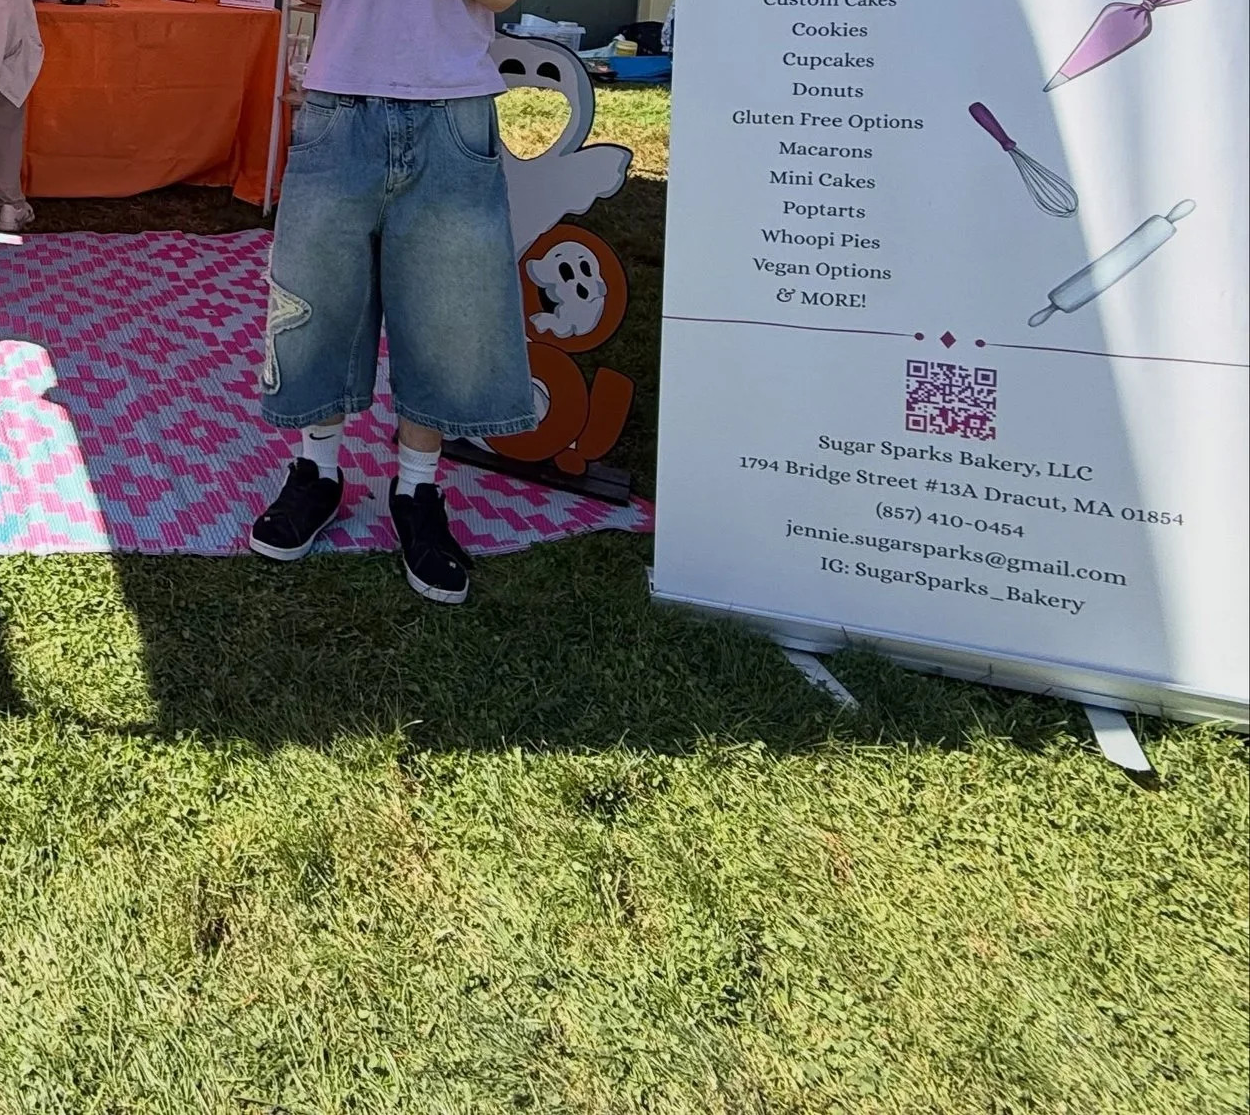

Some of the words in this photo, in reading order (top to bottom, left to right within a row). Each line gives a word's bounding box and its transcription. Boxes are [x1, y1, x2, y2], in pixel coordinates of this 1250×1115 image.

[792, 22, 868, 38] Cookies
[782, 52, 875, 70] Cupcakes
[792, 83, 864, 99] Donuts
[732, 111, 794, 126] Gluten
[800, 113, 842, 128] Free
[848, 114, 924, 132] Options
[778, 142, 873, 159] Macarons
[769, 170, 813, 187] Mini
[818, 173, 876, 190] Cakes
[783, 201, 866, 220] Poptarts
[761, 228, 836, 250] Whoopi
[840, 234, 881, 250] Pies
[752, 258, 811, 278] Vegan
[816, 262, 892, 281] Options
[776, 287, 796, 304] &
[800, 291, 867, 309] MORE!
[818, 435, 875, 457] Sugar
[880, 441, 953, 465] Sparks
[960, 450, 1041, 477] Bakery,
[1047, 461, 1093, 482] LLC
[739, 456, 779, 474] 1794
[785, 459, 851, 484] Bridge
[856, 469, 918, 491] Street
[925, 478, 978, 500] #13A
[984, 487, 1066, 513] Dracut,
[1074, 497, 1115, 519] MA
[1120, 506, 1184, 527] 01854
[875, 502, 922, 525] (857)
[927, 511, 1025, 539] 410-0454
[785, 519, 1127, 587] jennie.sugarsparks@gmail.com
[821, 556, 850, 576] IG:
[855, 562, 1086, 615] SugarSparks_Bakery
